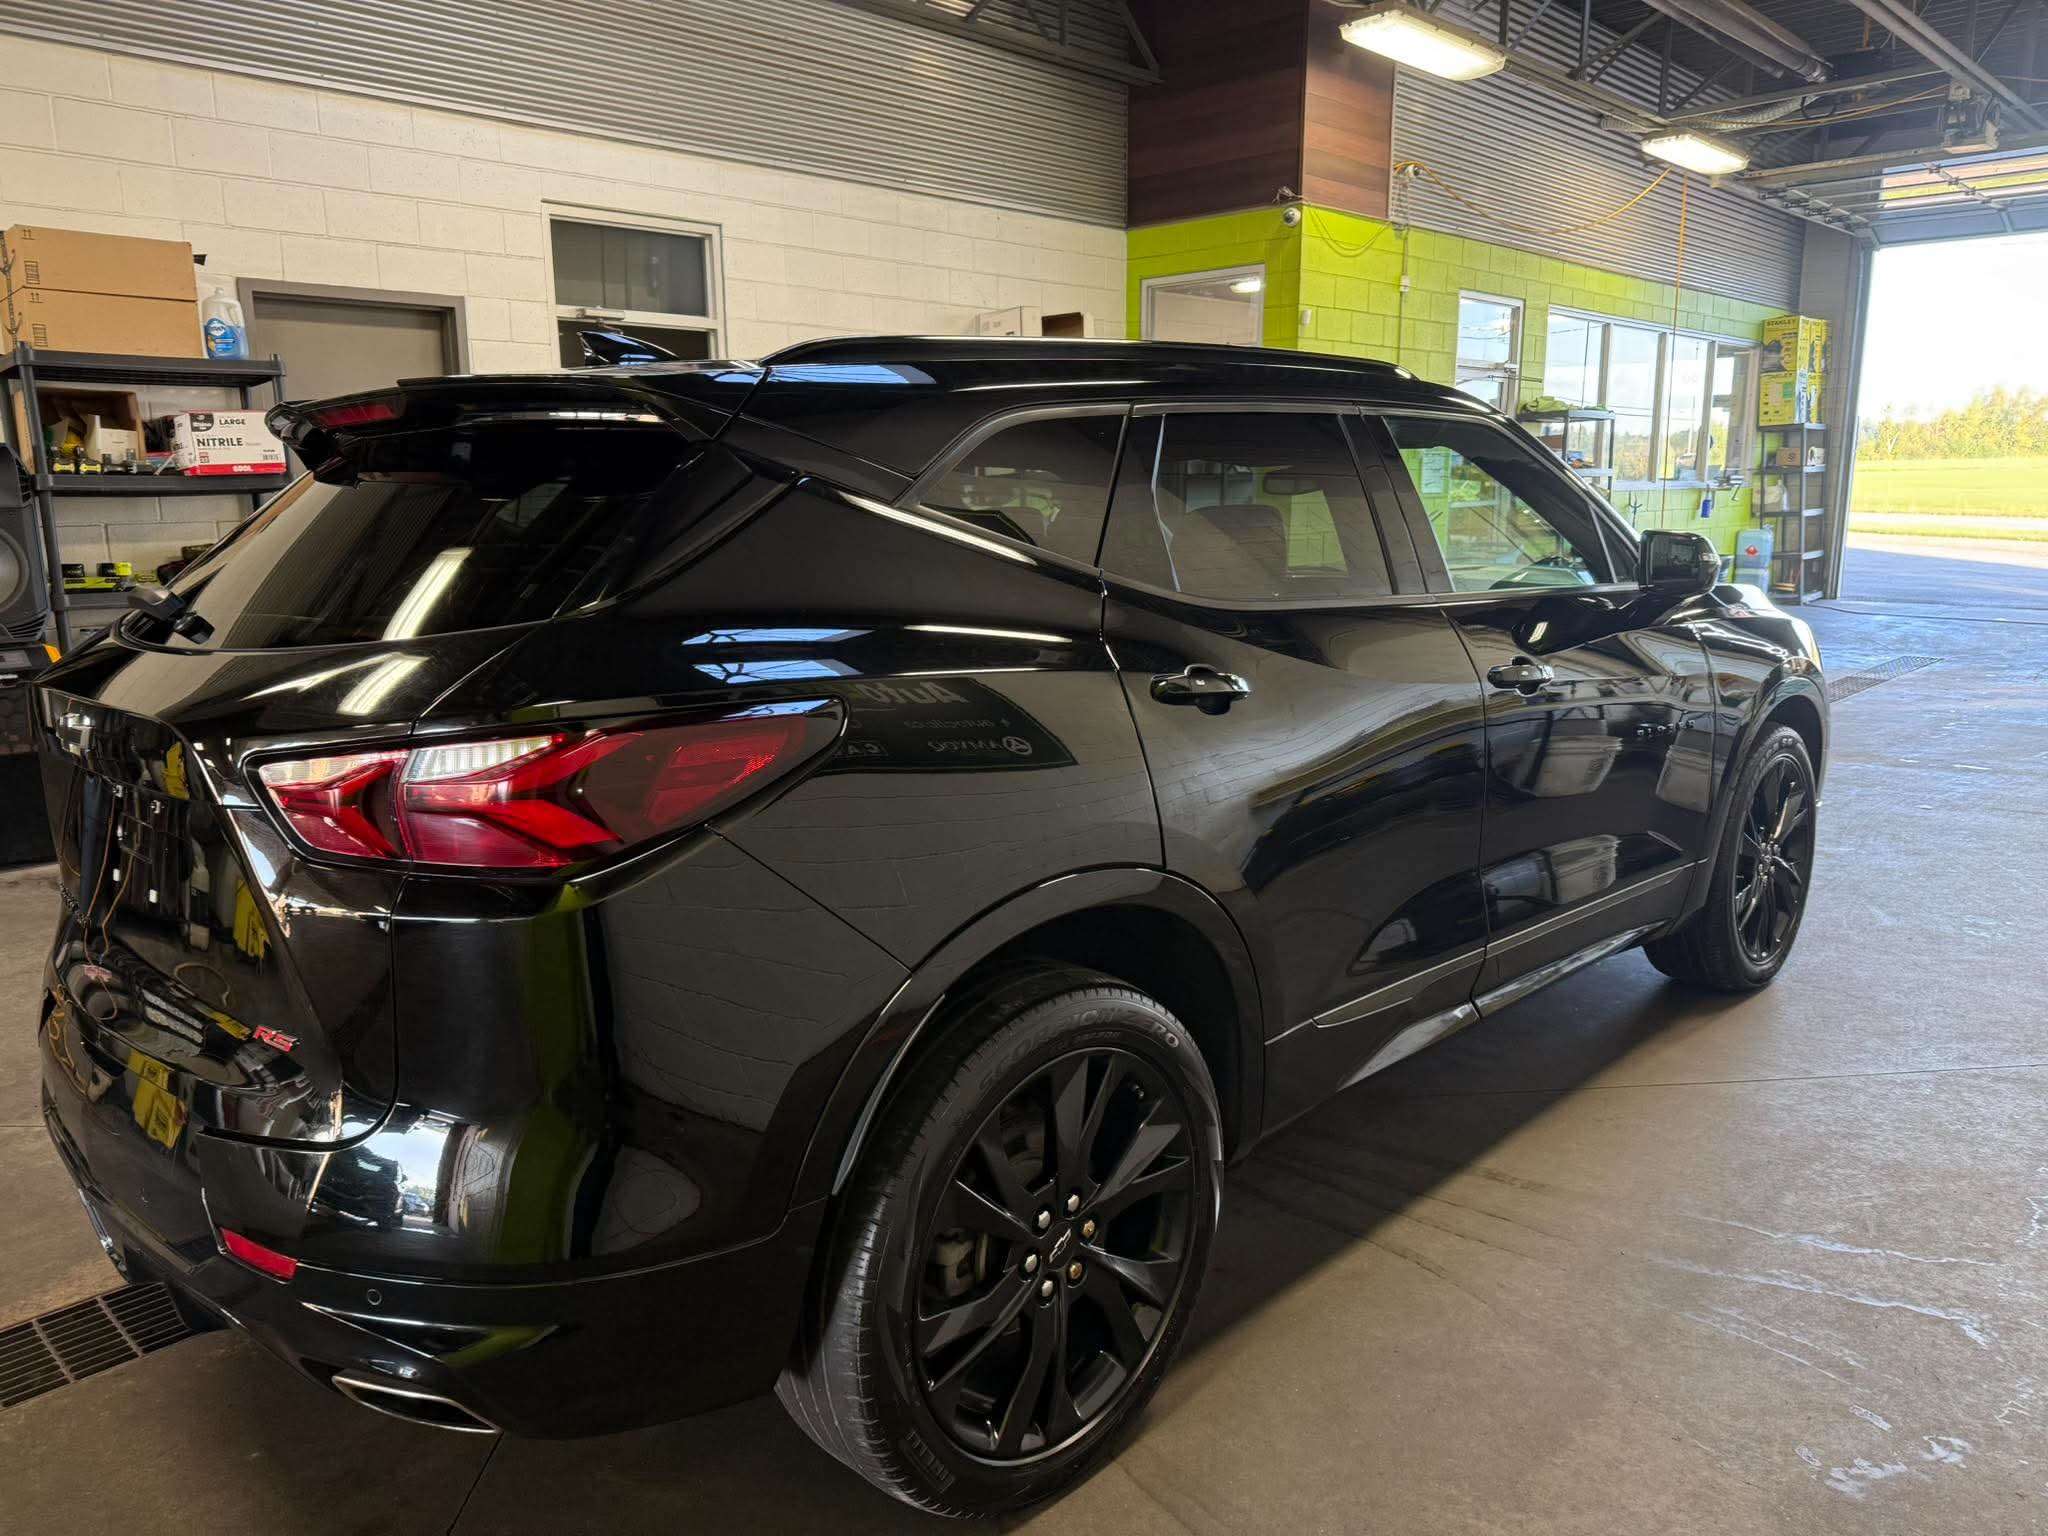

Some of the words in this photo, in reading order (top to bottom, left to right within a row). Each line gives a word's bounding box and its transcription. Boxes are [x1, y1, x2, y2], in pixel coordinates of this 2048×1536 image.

[1766, 319, 1796, 327] STANLEY
[219, 418, 246, 426] LARGE
[196, 437, 244, 447] NITRILE
[253, 1025, 298, 1053] RS
